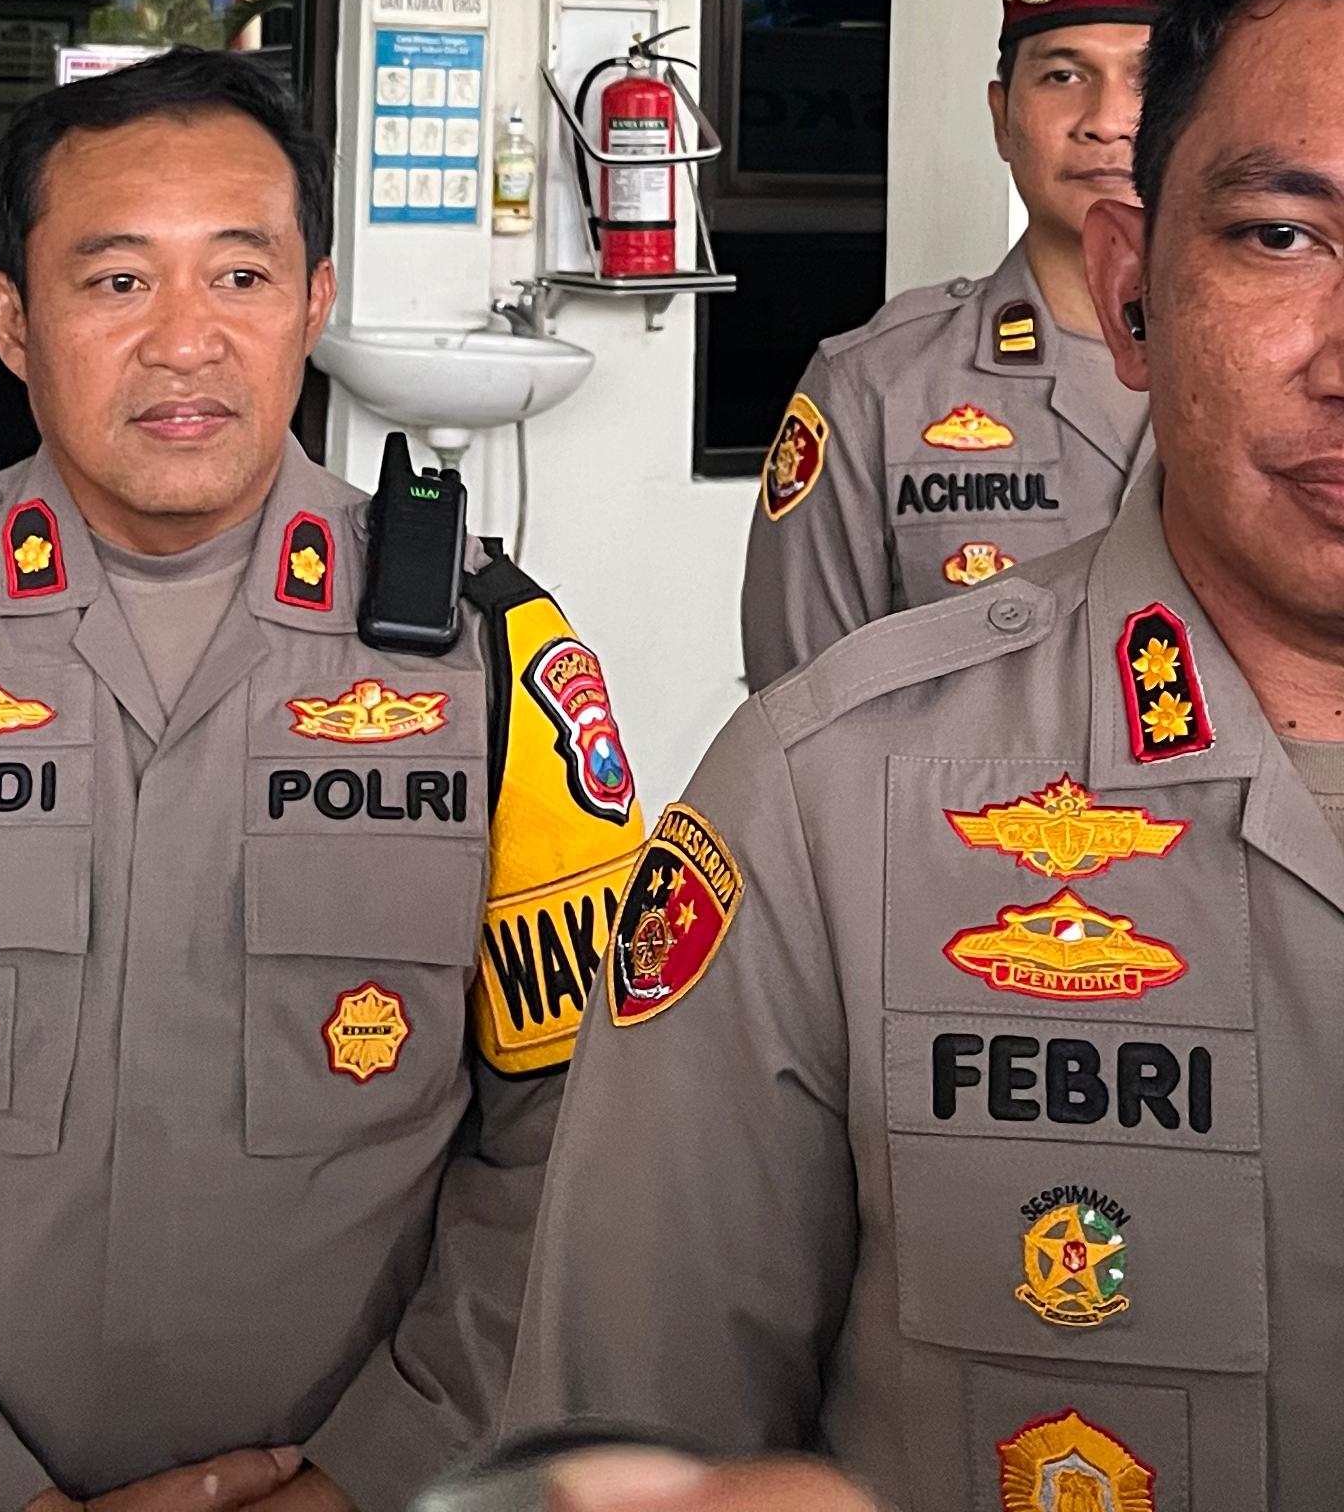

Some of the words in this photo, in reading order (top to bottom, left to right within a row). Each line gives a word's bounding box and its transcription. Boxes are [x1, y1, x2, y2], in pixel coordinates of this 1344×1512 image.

[897, 472, 1059, 516] ACHIRUL
[269, 769, 467, 822] POLRI
[483, 887, 619, 1031] WAK
[1015, 966, 1121, 989] PENYIDIK
[933, 1033, 1212, 1134] FEBRI
[1021, 1185, 1132, 1229] SESPIMMEN
